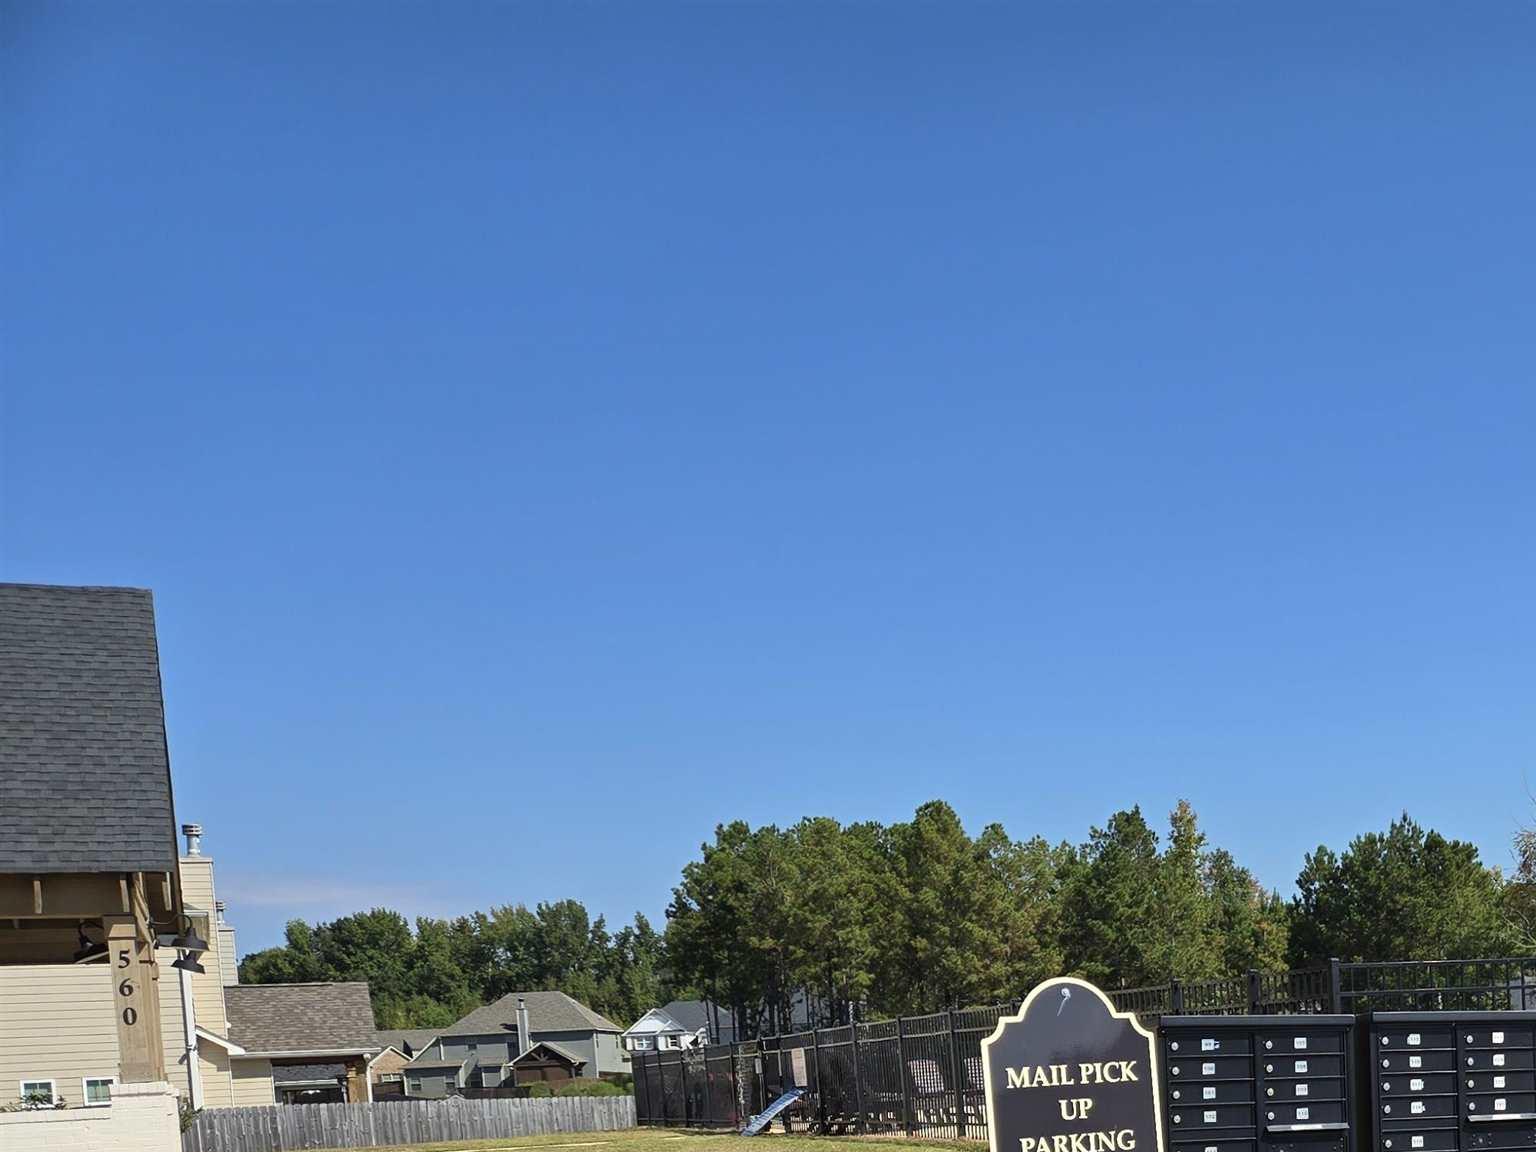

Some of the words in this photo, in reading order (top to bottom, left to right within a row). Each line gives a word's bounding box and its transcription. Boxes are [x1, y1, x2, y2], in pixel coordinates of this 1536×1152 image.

[118, 950, 137, 1025] 560
[1006, 1064, 1074, 1088] MAIL
[1080, 1061, 1138, 1083] PICK
[1058, 1098, 1093, 1120] UP
